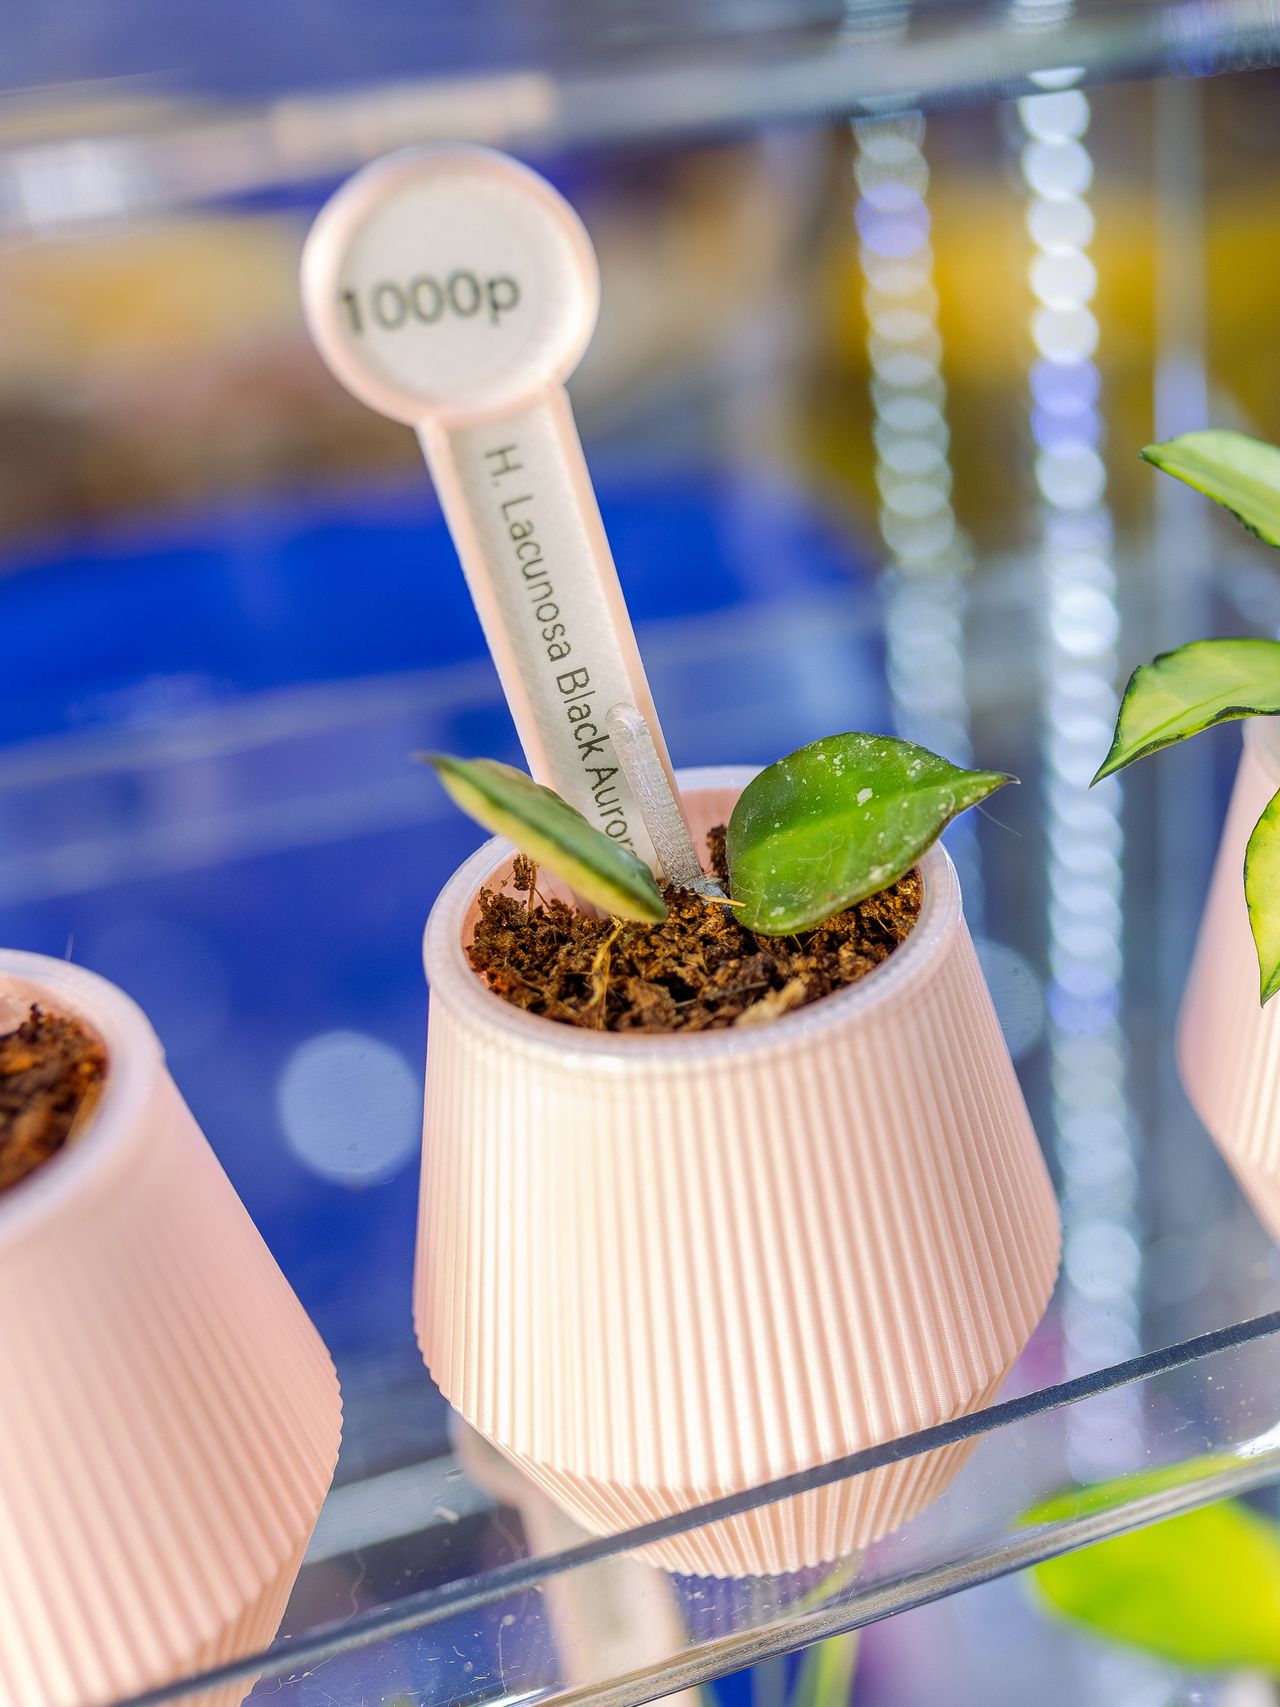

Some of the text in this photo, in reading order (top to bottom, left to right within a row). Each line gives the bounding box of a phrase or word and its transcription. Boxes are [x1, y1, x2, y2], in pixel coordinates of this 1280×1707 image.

[341, 269, 521, 335] 1000p
[484, 444, 638, 857] H. Lacunosa Black Auror
